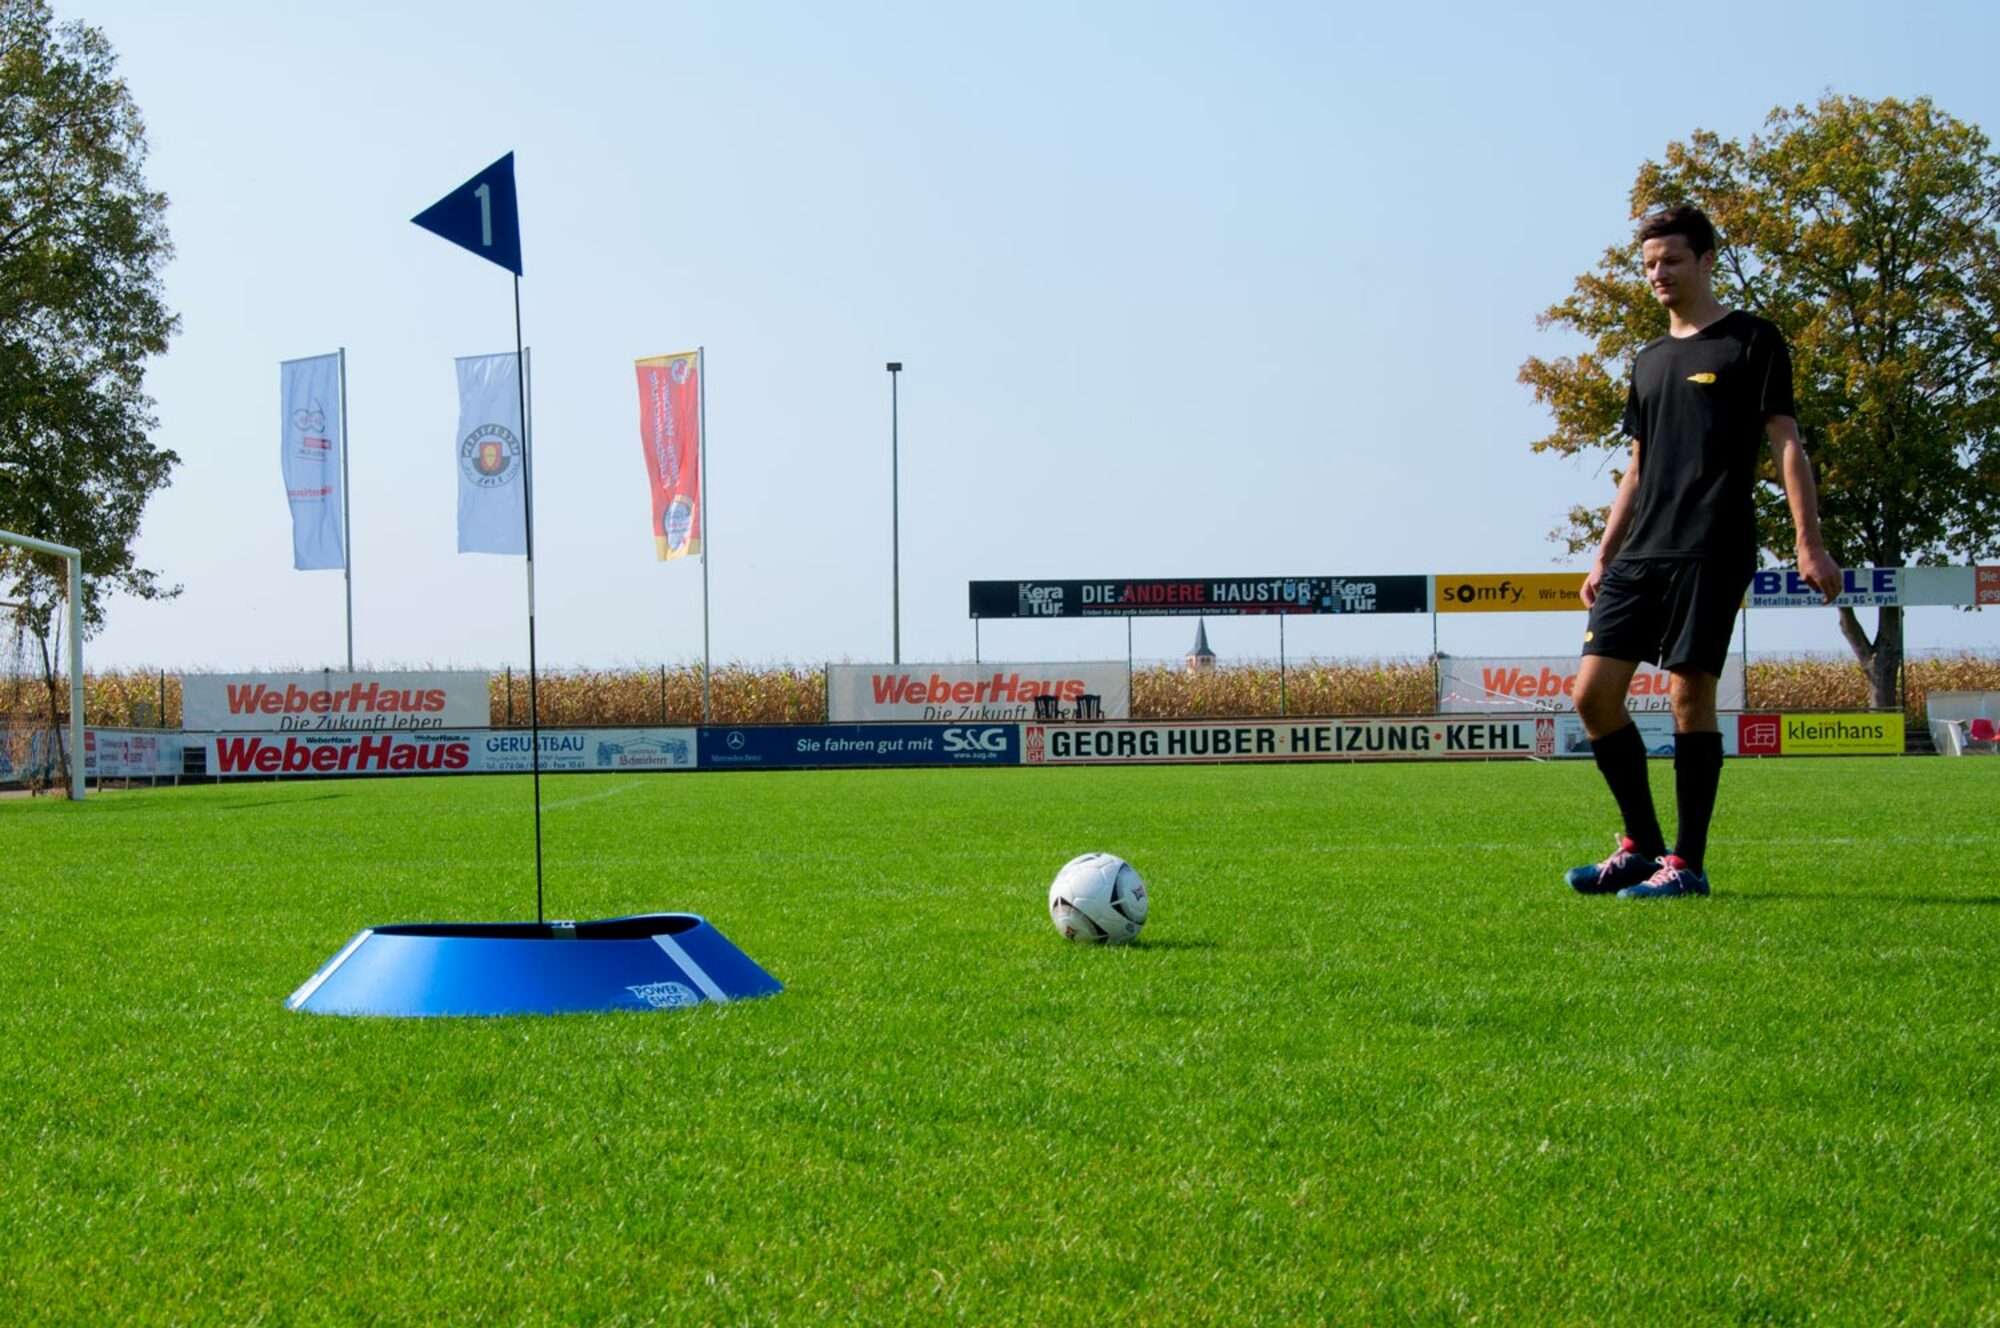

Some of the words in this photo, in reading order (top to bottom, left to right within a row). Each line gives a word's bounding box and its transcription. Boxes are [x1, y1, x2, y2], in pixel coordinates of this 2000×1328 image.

[474, 182, 492, 247] 1
[1018, 583, 1064, 600] Kera
[1082, 584, 1115, 604] DIE
[1121, 583, 1204, 603] ANDERE
[1213, 579, 1312, 603] HAUSTÜR
[1331, 579, 1376, 596] Kera
[1443, 581, 1523, 604] somfy
[1753, 570, 1897, 594] BELE
[1029, 599, 1063, 615] Tür
[1342, 595, 1376, 611] Tür
[226, 682, 446, 714] WeberHaus
[871, 672, 1085, 704] WeberHaus
[279, 715, 310, 731] Die
[316, 714, 387, 733] Zukunft
[923, 706, 952, 721] Die
[958, 704, 1026, 722] Zukunft
[943, 727, 1008, 752] S&G
[1052, 730, 1159, 757] GEORG
[1168, 728, 1275, 755] HUBER
[1290, 725, 1429, 752] HEIZUNG
[1446, 724, 1530, 750] KEHL
[1788, 721, 1884, 740] kleinhans
[215, 735, 471, 773] WeberHaus
[797, 738, 821, 752] Sie
[825, 737, 874, 751] fahren
[877, 738, 904, 754] gut
[907, 736, 934, 751] mit
[1028, 751, 1044, 762] GH
